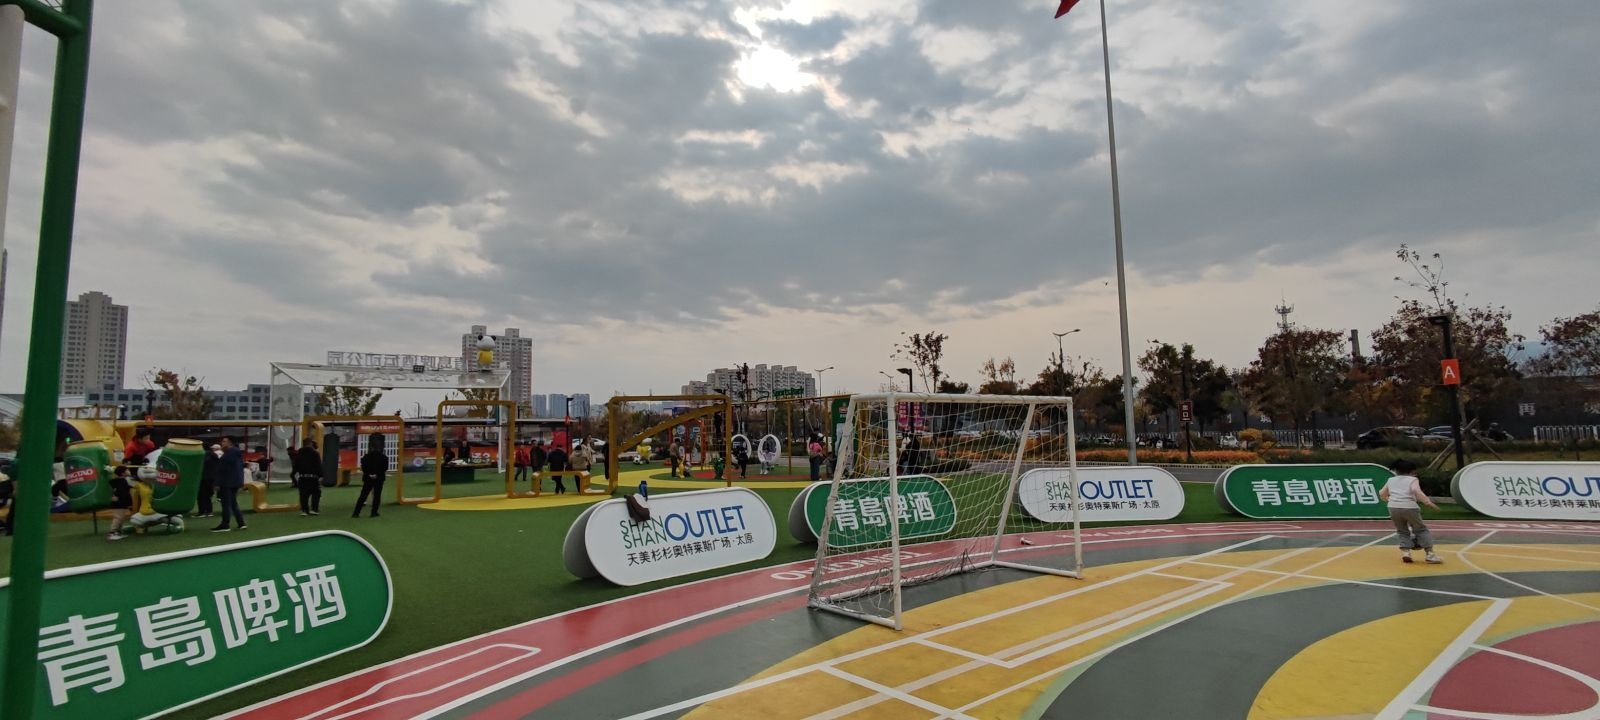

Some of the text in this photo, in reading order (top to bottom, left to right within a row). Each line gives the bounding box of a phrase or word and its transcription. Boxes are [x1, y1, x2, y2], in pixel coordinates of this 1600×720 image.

[1444, 365, 1456, 379] A
[1080, 479, 1154, 500] OUTLET
[1251, 477, 1380, 506] 青島啤酒
[1493, 476, 1542, 487] SHAN
[1495, 485, 1544, 496] SHAN
[619, 514, 664, 537] SHAN
[665, 504, 746, 541] OUTLET
[623, 529, 668, 550] SHAN
[37, 564, 347, 707] 青島啤酒
